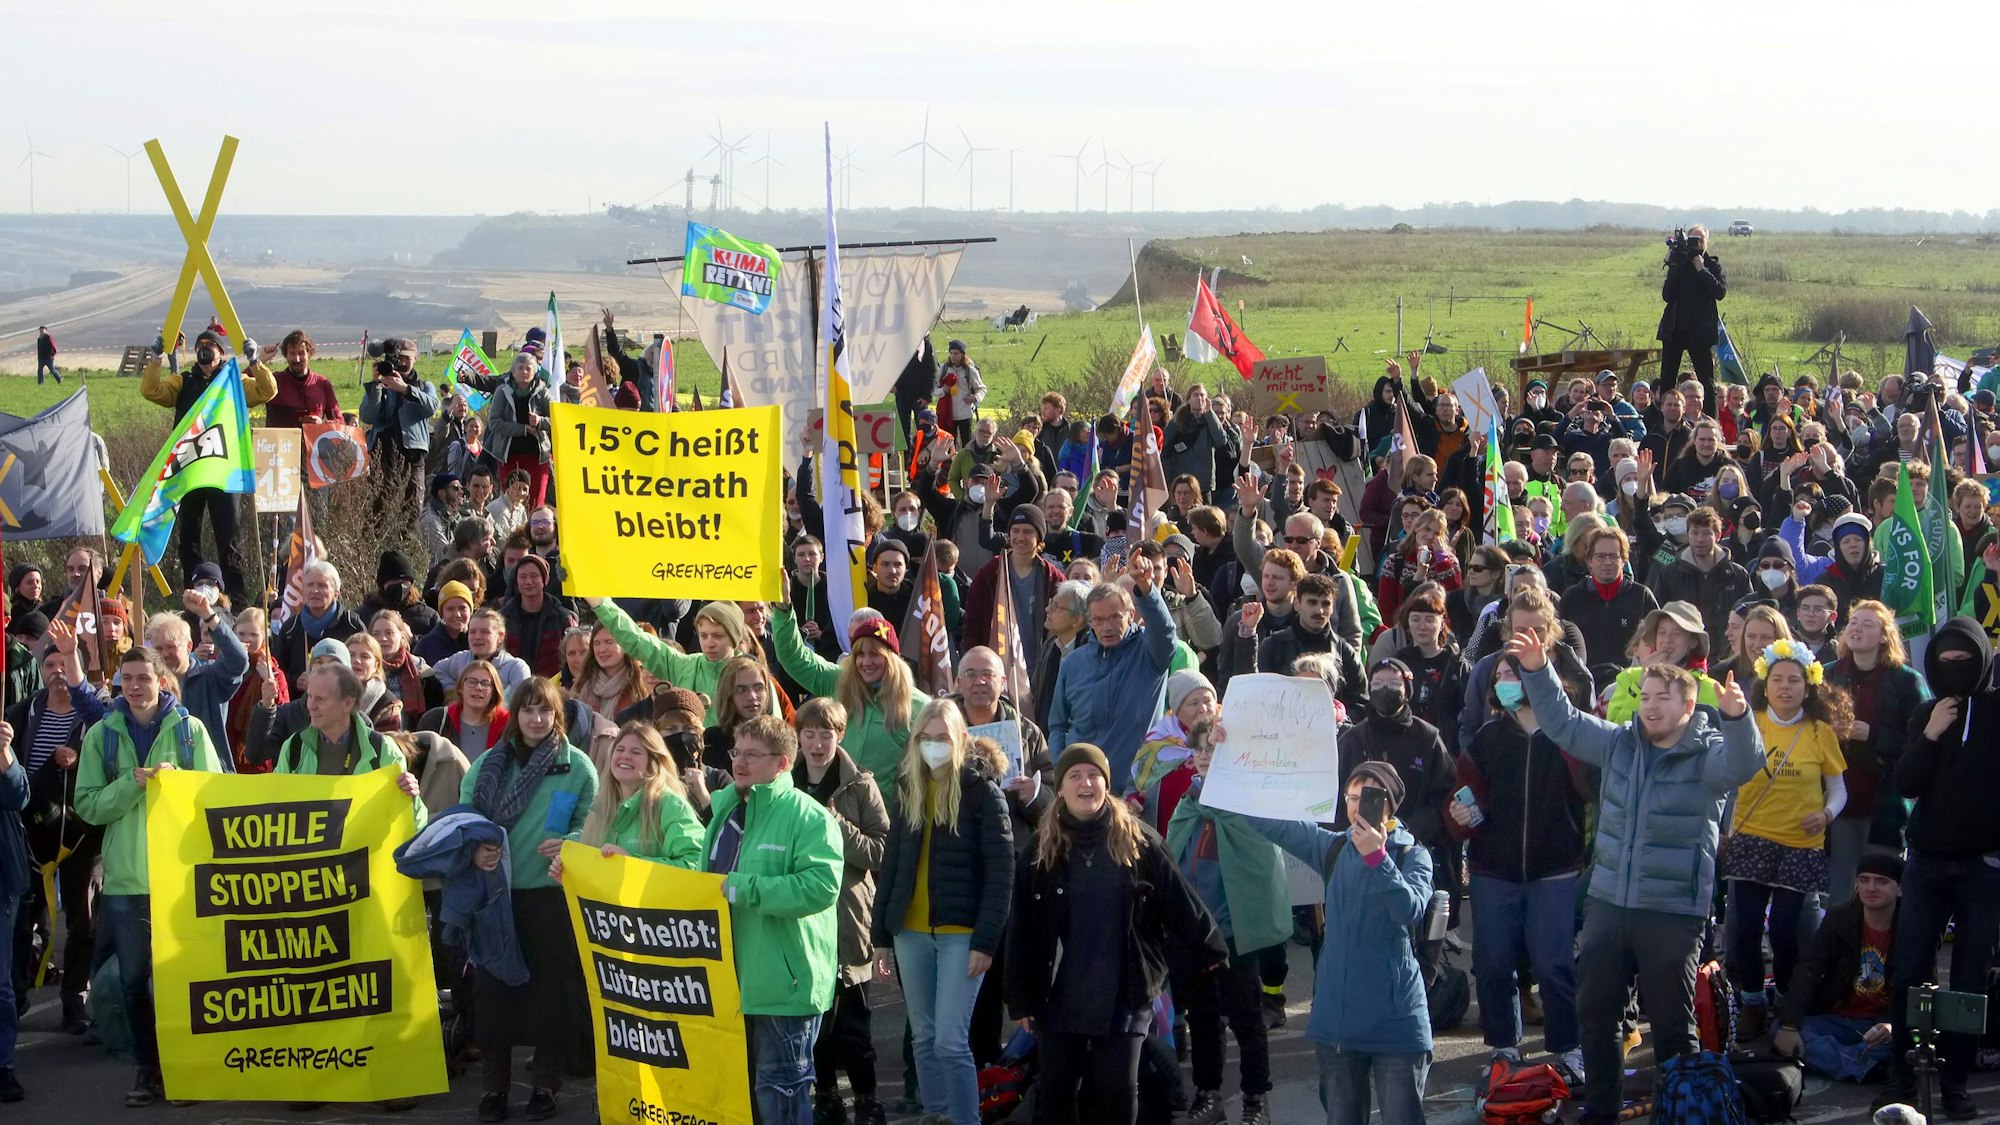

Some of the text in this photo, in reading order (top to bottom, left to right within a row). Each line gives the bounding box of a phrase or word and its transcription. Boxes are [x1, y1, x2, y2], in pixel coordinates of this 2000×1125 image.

[713, 247, 766, 274] KLIMA
[705, 265, 772, 294] RETTEN!
[460, 347, 491, 376] KLIM
[1723, 353, 1734, 361] FU
[1258, 364, 1304, 381] Nicht
[1267, 380, 1288, 392] mit
[256, 438, 293, 453] Hier ist
[575, 423, 660, 456] 1,5°C
[670, 428, 759, 457] heißt
[268, 453, 285, 466] die
[582, 466, 748, 498] Lützerath
[615, 511, 721, 540] bleibt!
[652, 562, 757, 580] GREENPEACE
[1901, 550, 1921, 591] FOR
[222, 811, 329, 849] KOHLE
[210, 864, 357, 906] STOPPEN,
[240, 925, 338, 962] KLIMA
[636, 916, 717, 949] heißt:
[598, 960, 708, 1005] Lützerath
[203, 972, 379, 1025] SCHÜTZEN!
[608, 1016, 679, 1057] bleibt!
[224, 1046, 374, 1072] GREENPEACE
